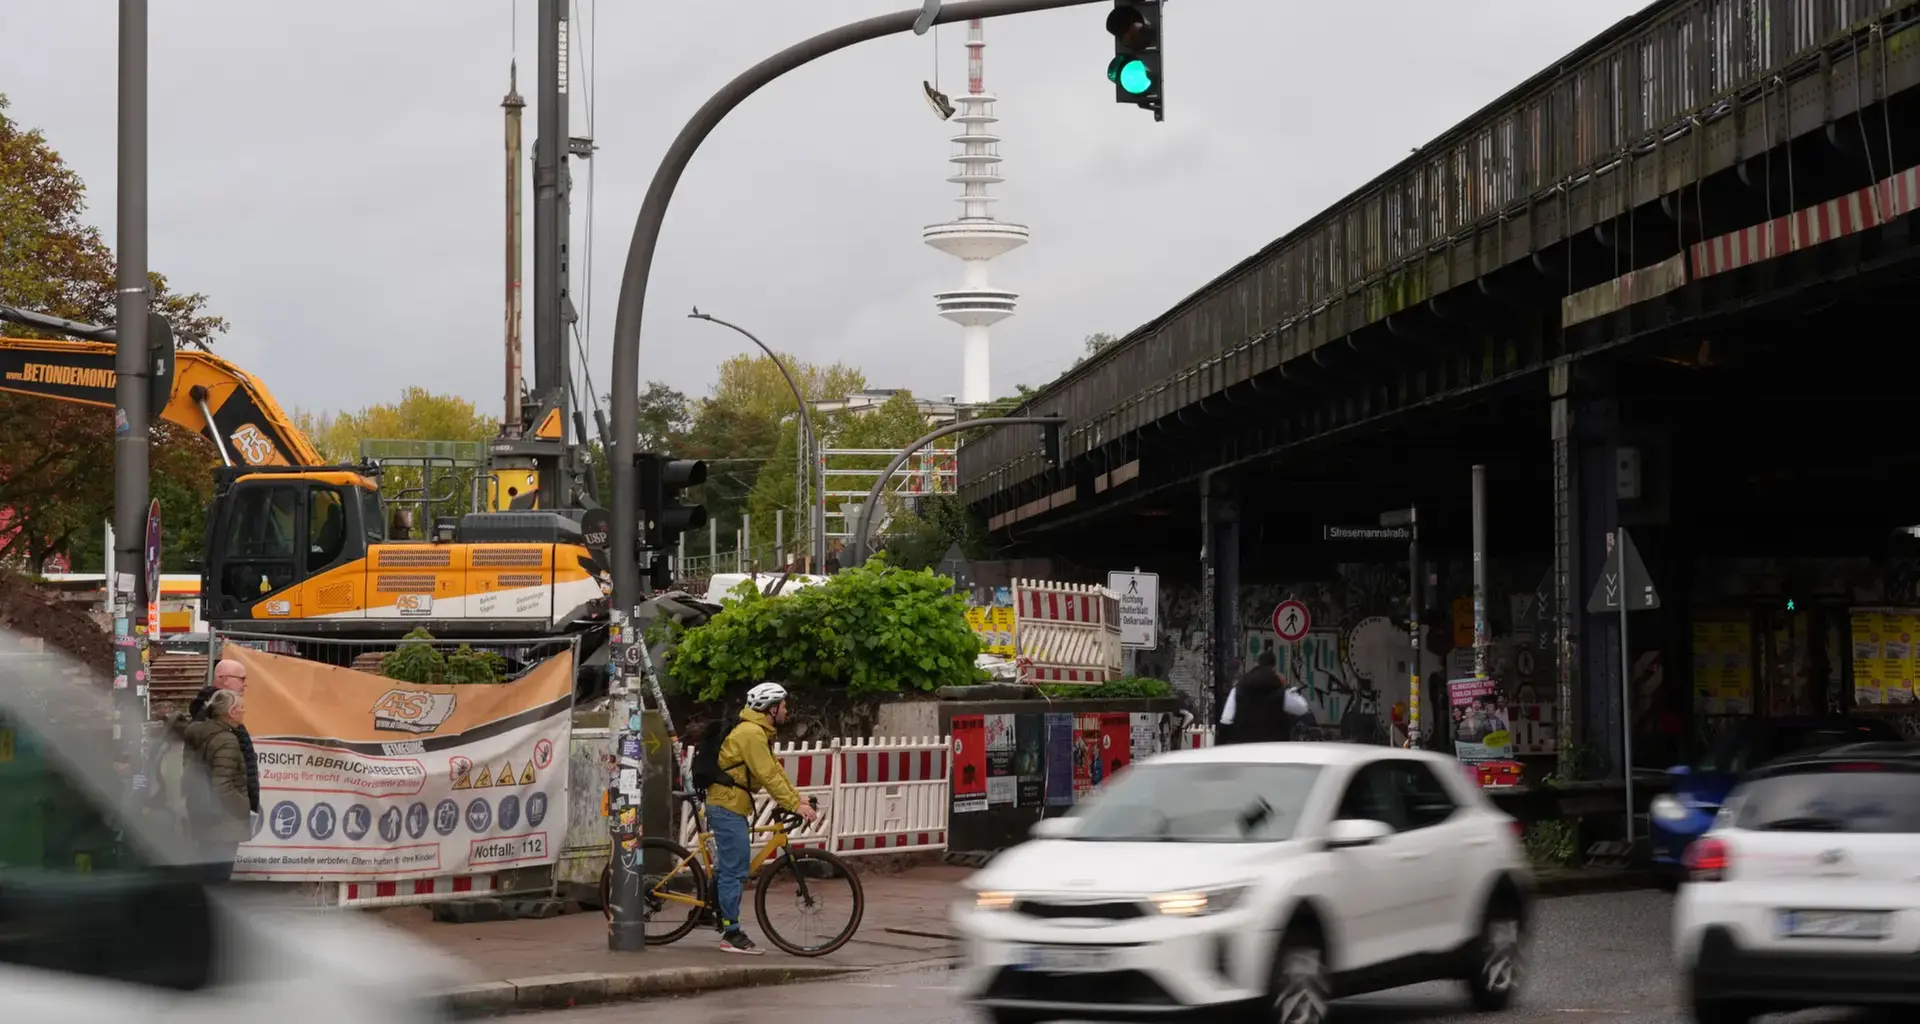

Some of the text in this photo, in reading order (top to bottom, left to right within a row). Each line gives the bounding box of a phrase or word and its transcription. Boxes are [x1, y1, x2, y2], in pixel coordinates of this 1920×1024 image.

[557, 20, 568, 94] LIEBHERR
[1329, 527, 1410, 538] Stresemannstraße
[1119, 605, 1149, 614] chulterblatt
[257, 752, 423, 776] RSICHT ABBRUCHARBEITEN
[263, 769, 299, 781] Zugang
[316, 773, 341, 783] nicht
[474, 838, 542, 859] Notfall: 112
[268, 855, 281, 864] der
[282, 855, 316, 865] Baustelle
